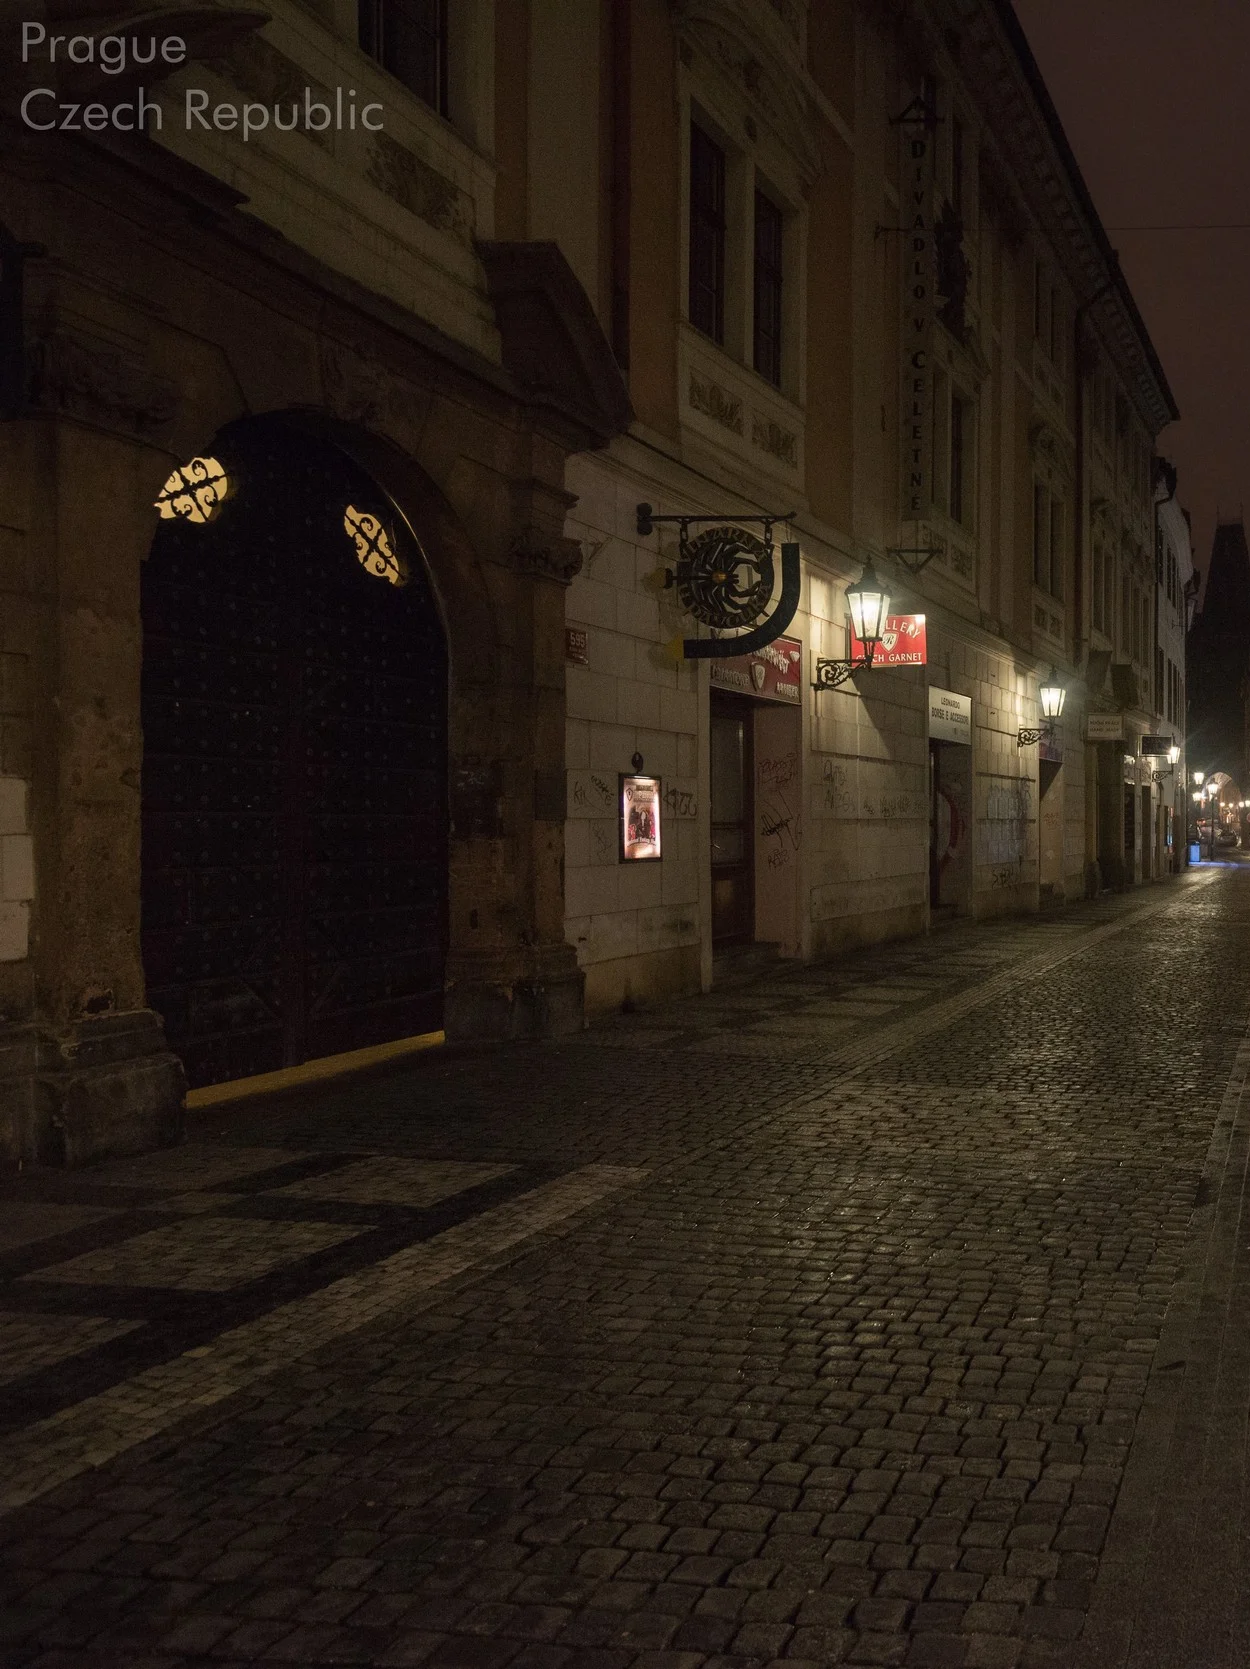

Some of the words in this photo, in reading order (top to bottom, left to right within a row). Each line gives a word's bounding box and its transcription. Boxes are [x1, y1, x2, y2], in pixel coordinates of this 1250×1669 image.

[911, 139, 926, 299] DIVADLO
[913, 318, 925, 333] V
[888, 652, 922, 662] GARNET
[941, 697, 960, 709] LEONARDO
